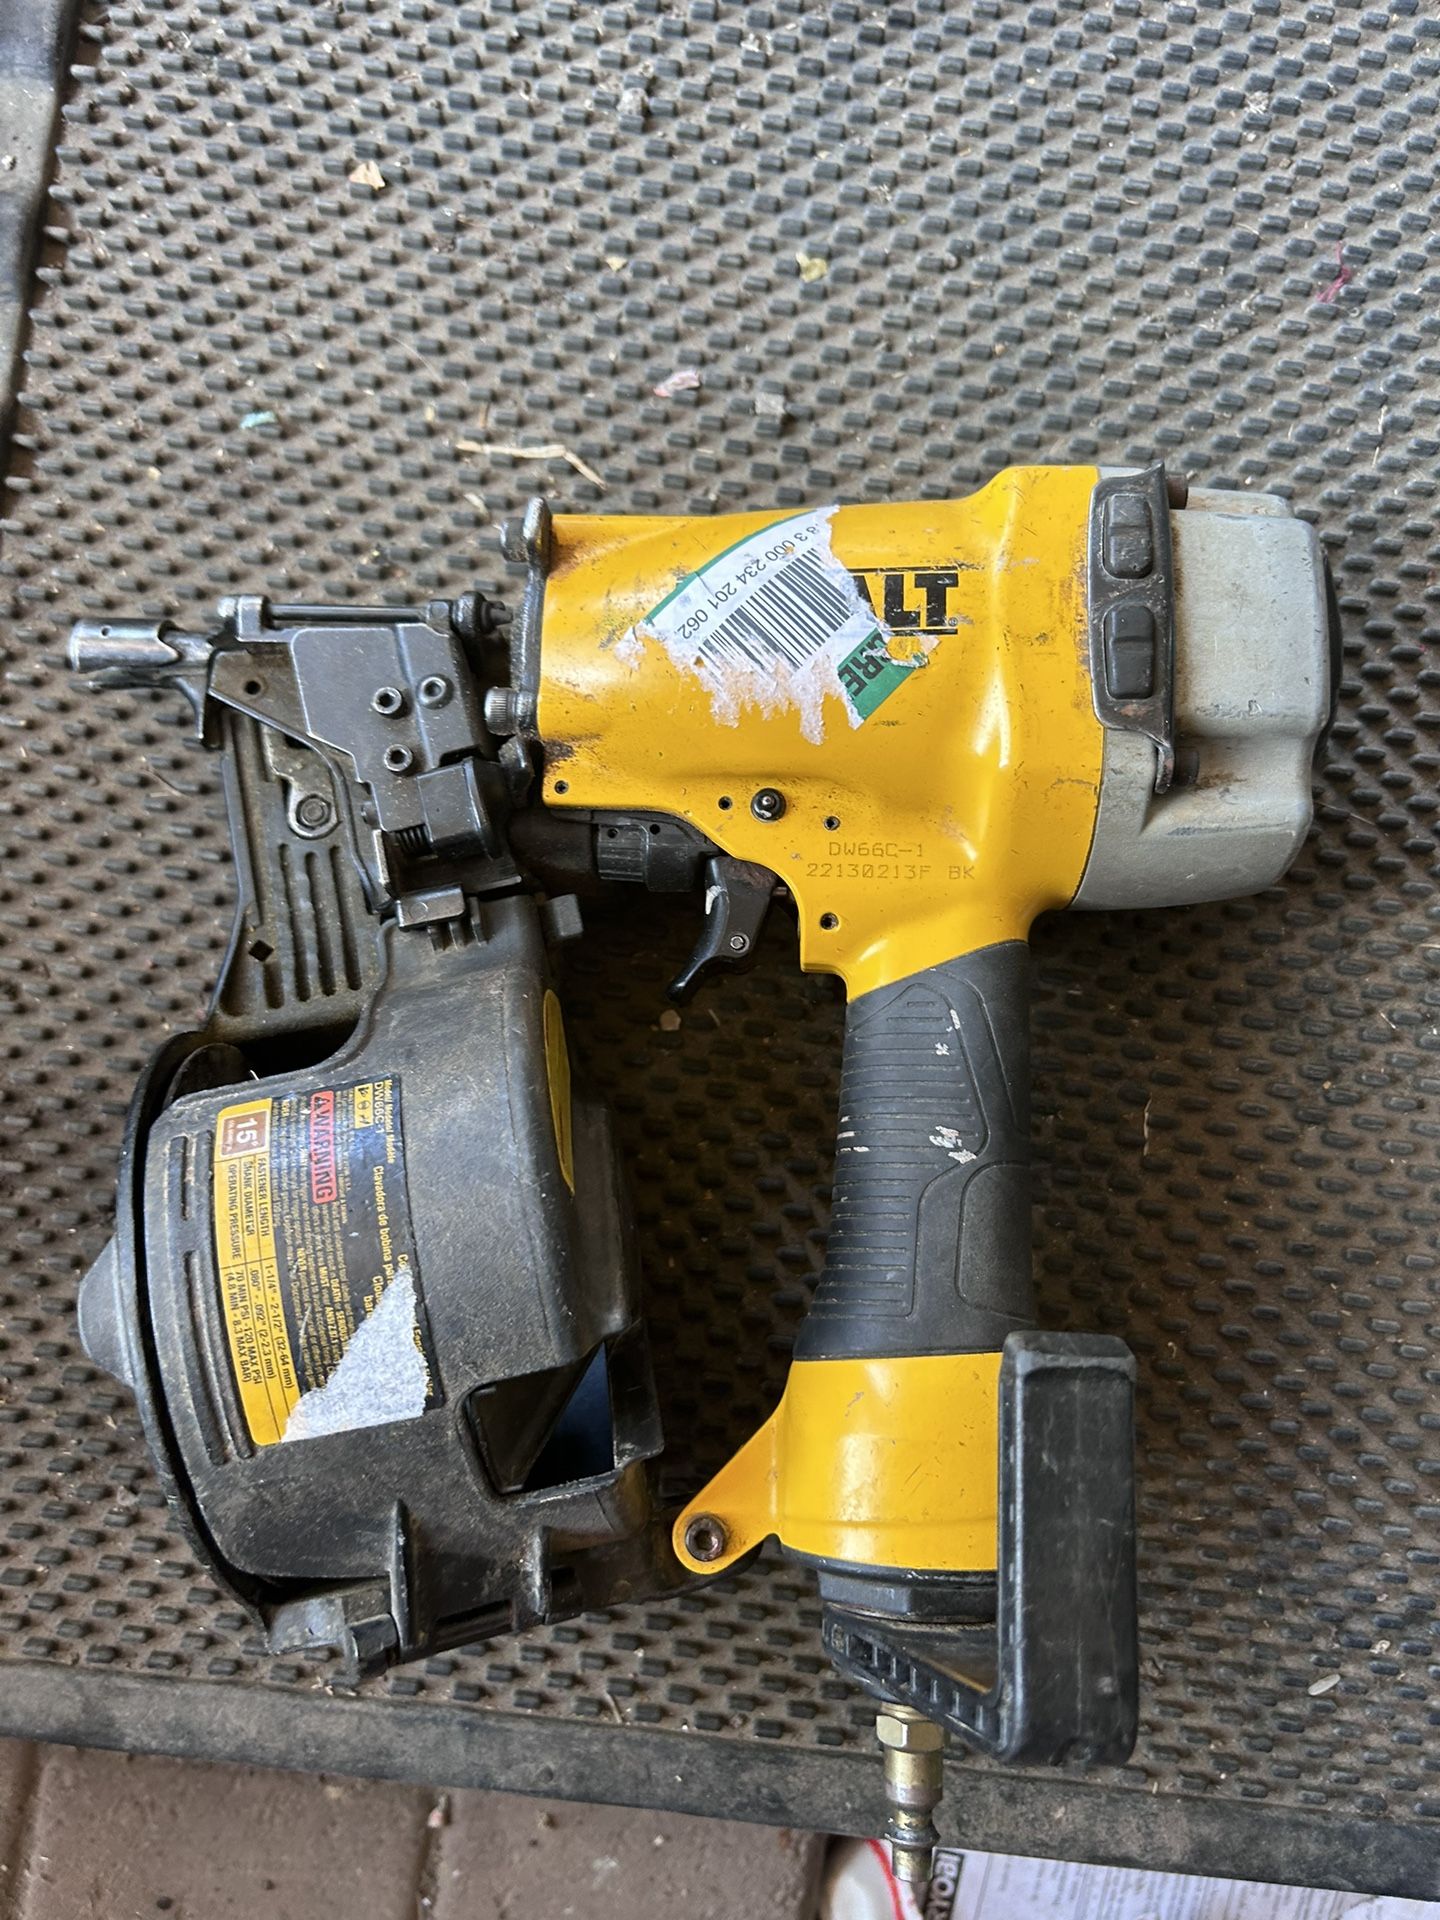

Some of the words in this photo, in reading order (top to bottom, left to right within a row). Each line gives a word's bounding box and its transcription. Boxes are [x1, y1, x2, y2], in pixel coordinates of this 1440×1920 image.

[736, 559, 766, 584] 234
[708, 582, 737, 610] 201
[677, 609, 708, 640] 062
[829, 842, 923, 858] DW66C-1
[806, 863, 932, 879] 22130213F
[948, 865, 976, 880] BK
[312, 1110, 334, 1199] WARNING
[243, 1160, 252, 1188] SHANK
[257, 1157, 267, 1200] FASTENER
[227, 1164, 237, 1211] OPERATING
[373, 1165, 386, 1211] Clavadora
[243, 1190, 255, 1236] DIAMETER
[258, 1202, 270, 1236] LENGTH
[377, 1214, 388, 1225] de
[228, 1213, 240, 1260] PRESSURE
[379, 1227, 394, 1261] bobina
[296, 1247, 306, 1270] NEVER
[235, 1270, 244, 1281] 70
[265, 1264, 276, 1293] 1-1/4"
[229, 1292, 239, 1310] MIN
[237, 1283, 248, 1302] MIN
[318, 1266, 329, 1287] MUST
[324, 1306, 335, 1323] ANSI
[330, 1278, 341, 1301] DEATH
[240, 1304, 250, 1319] PSI
[270, 1303, 283, 1333] 2-1/2"
[335, 1310, 348, 1341] SERIOUS
[235, 1336, 248, 1357] MAX
[246, 1345, 258, 1366] MAX
[274, 1336, 290, 1366] (32-64
[240, 1360, 252, 1382] BAR)
[251, 1369, 262, 1384] PSI
[264, 1358, 276, 1379] mm)
[282, 1368, 294, 1389] mm)
